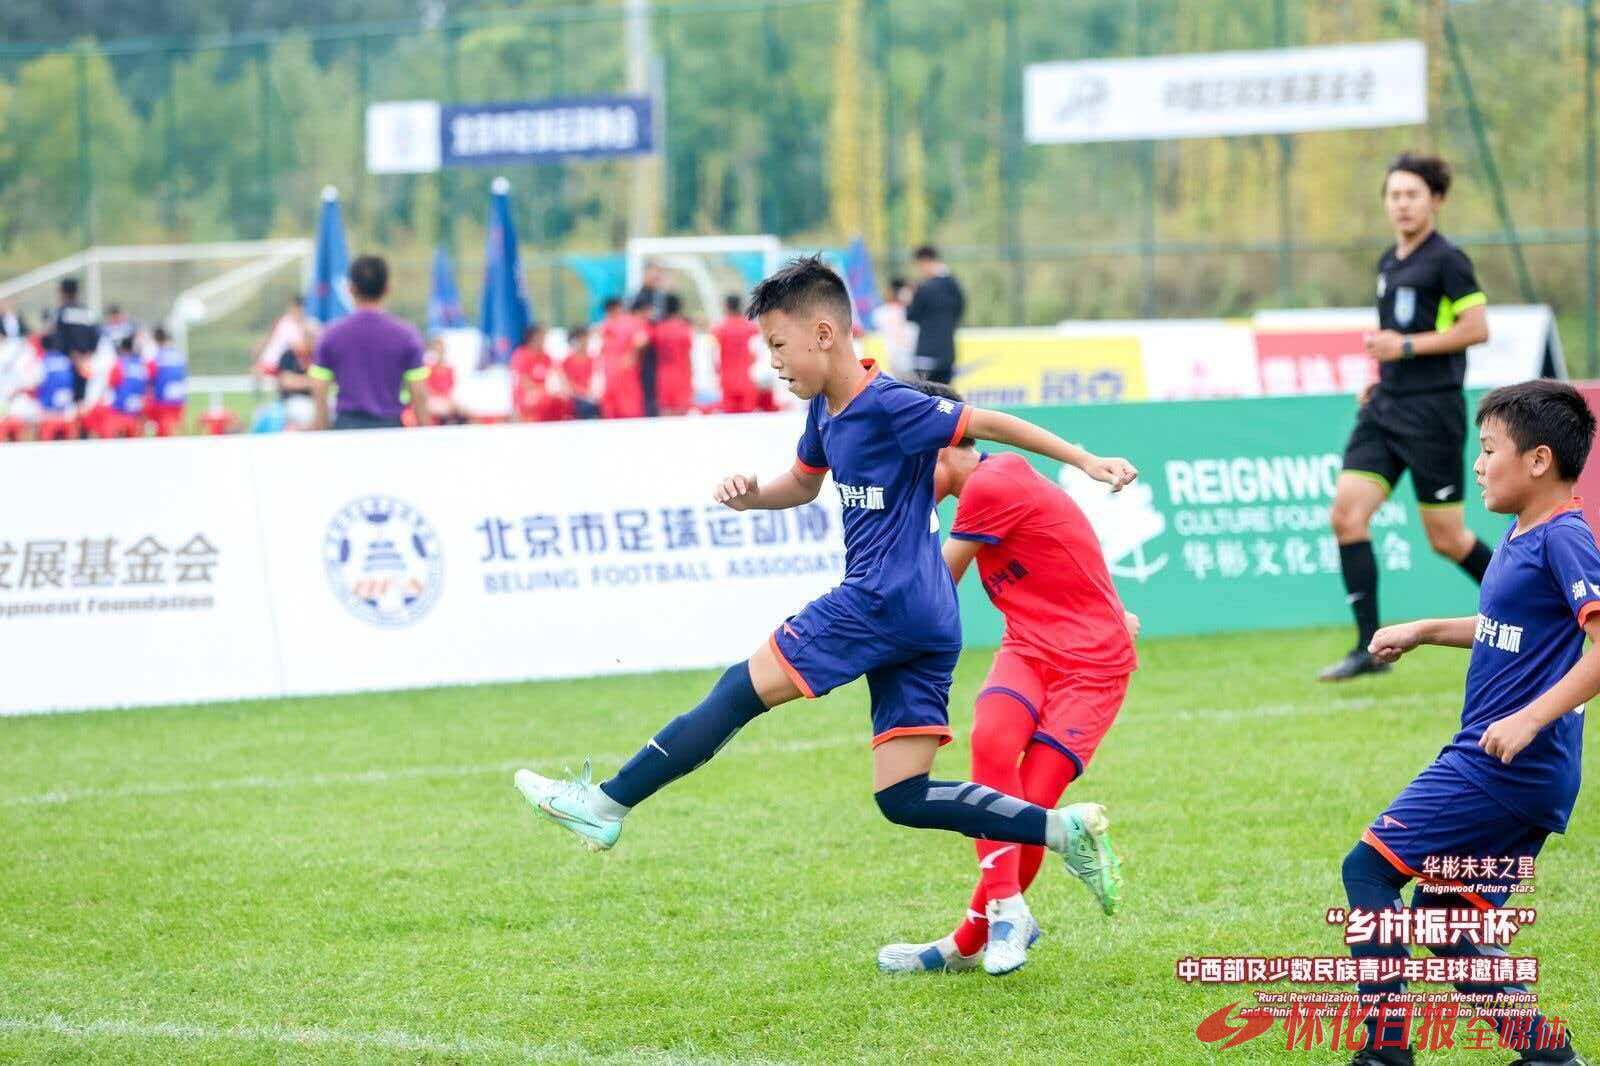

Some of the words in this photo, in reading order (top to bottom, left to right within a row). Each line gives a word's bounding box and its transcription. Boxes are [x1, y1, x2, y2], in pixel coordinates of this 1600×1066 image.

[483, 567, 580, 594] BEIJING
[592, 559, 713, 586] FOOTBALL
[87, 596, 214, 615] Foundation
